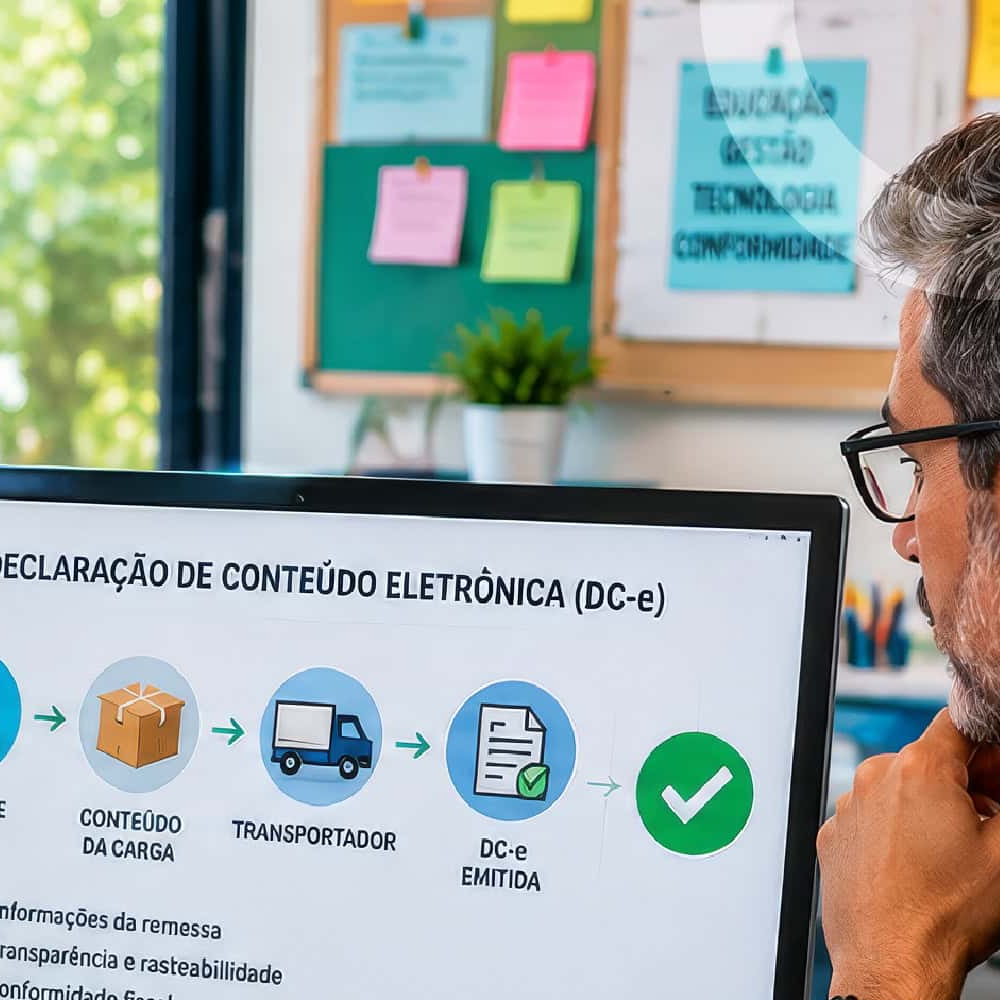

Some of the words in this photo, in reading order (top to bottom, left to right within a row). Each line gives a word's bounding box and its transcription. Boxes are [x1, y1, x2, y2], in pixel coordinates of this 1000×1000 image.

[177, 560, 213, 589] DE
[386, 566, 565, 609] ELETRÔNICA
[575, 578, 665, 618] (DC-e)
[231, 819, 397, 851] TRANSPORTADOR
[83, 836, 107, 857] DA
[111, 839, 175, 862] CARGA
[480, 837, 528, 861] DC-e
[461, 866, 542, 891] EMITIDA
[113, 911, 137, 932] da
[142, 917, 222, 940] remessa
[124, 956, 136, 971] e
